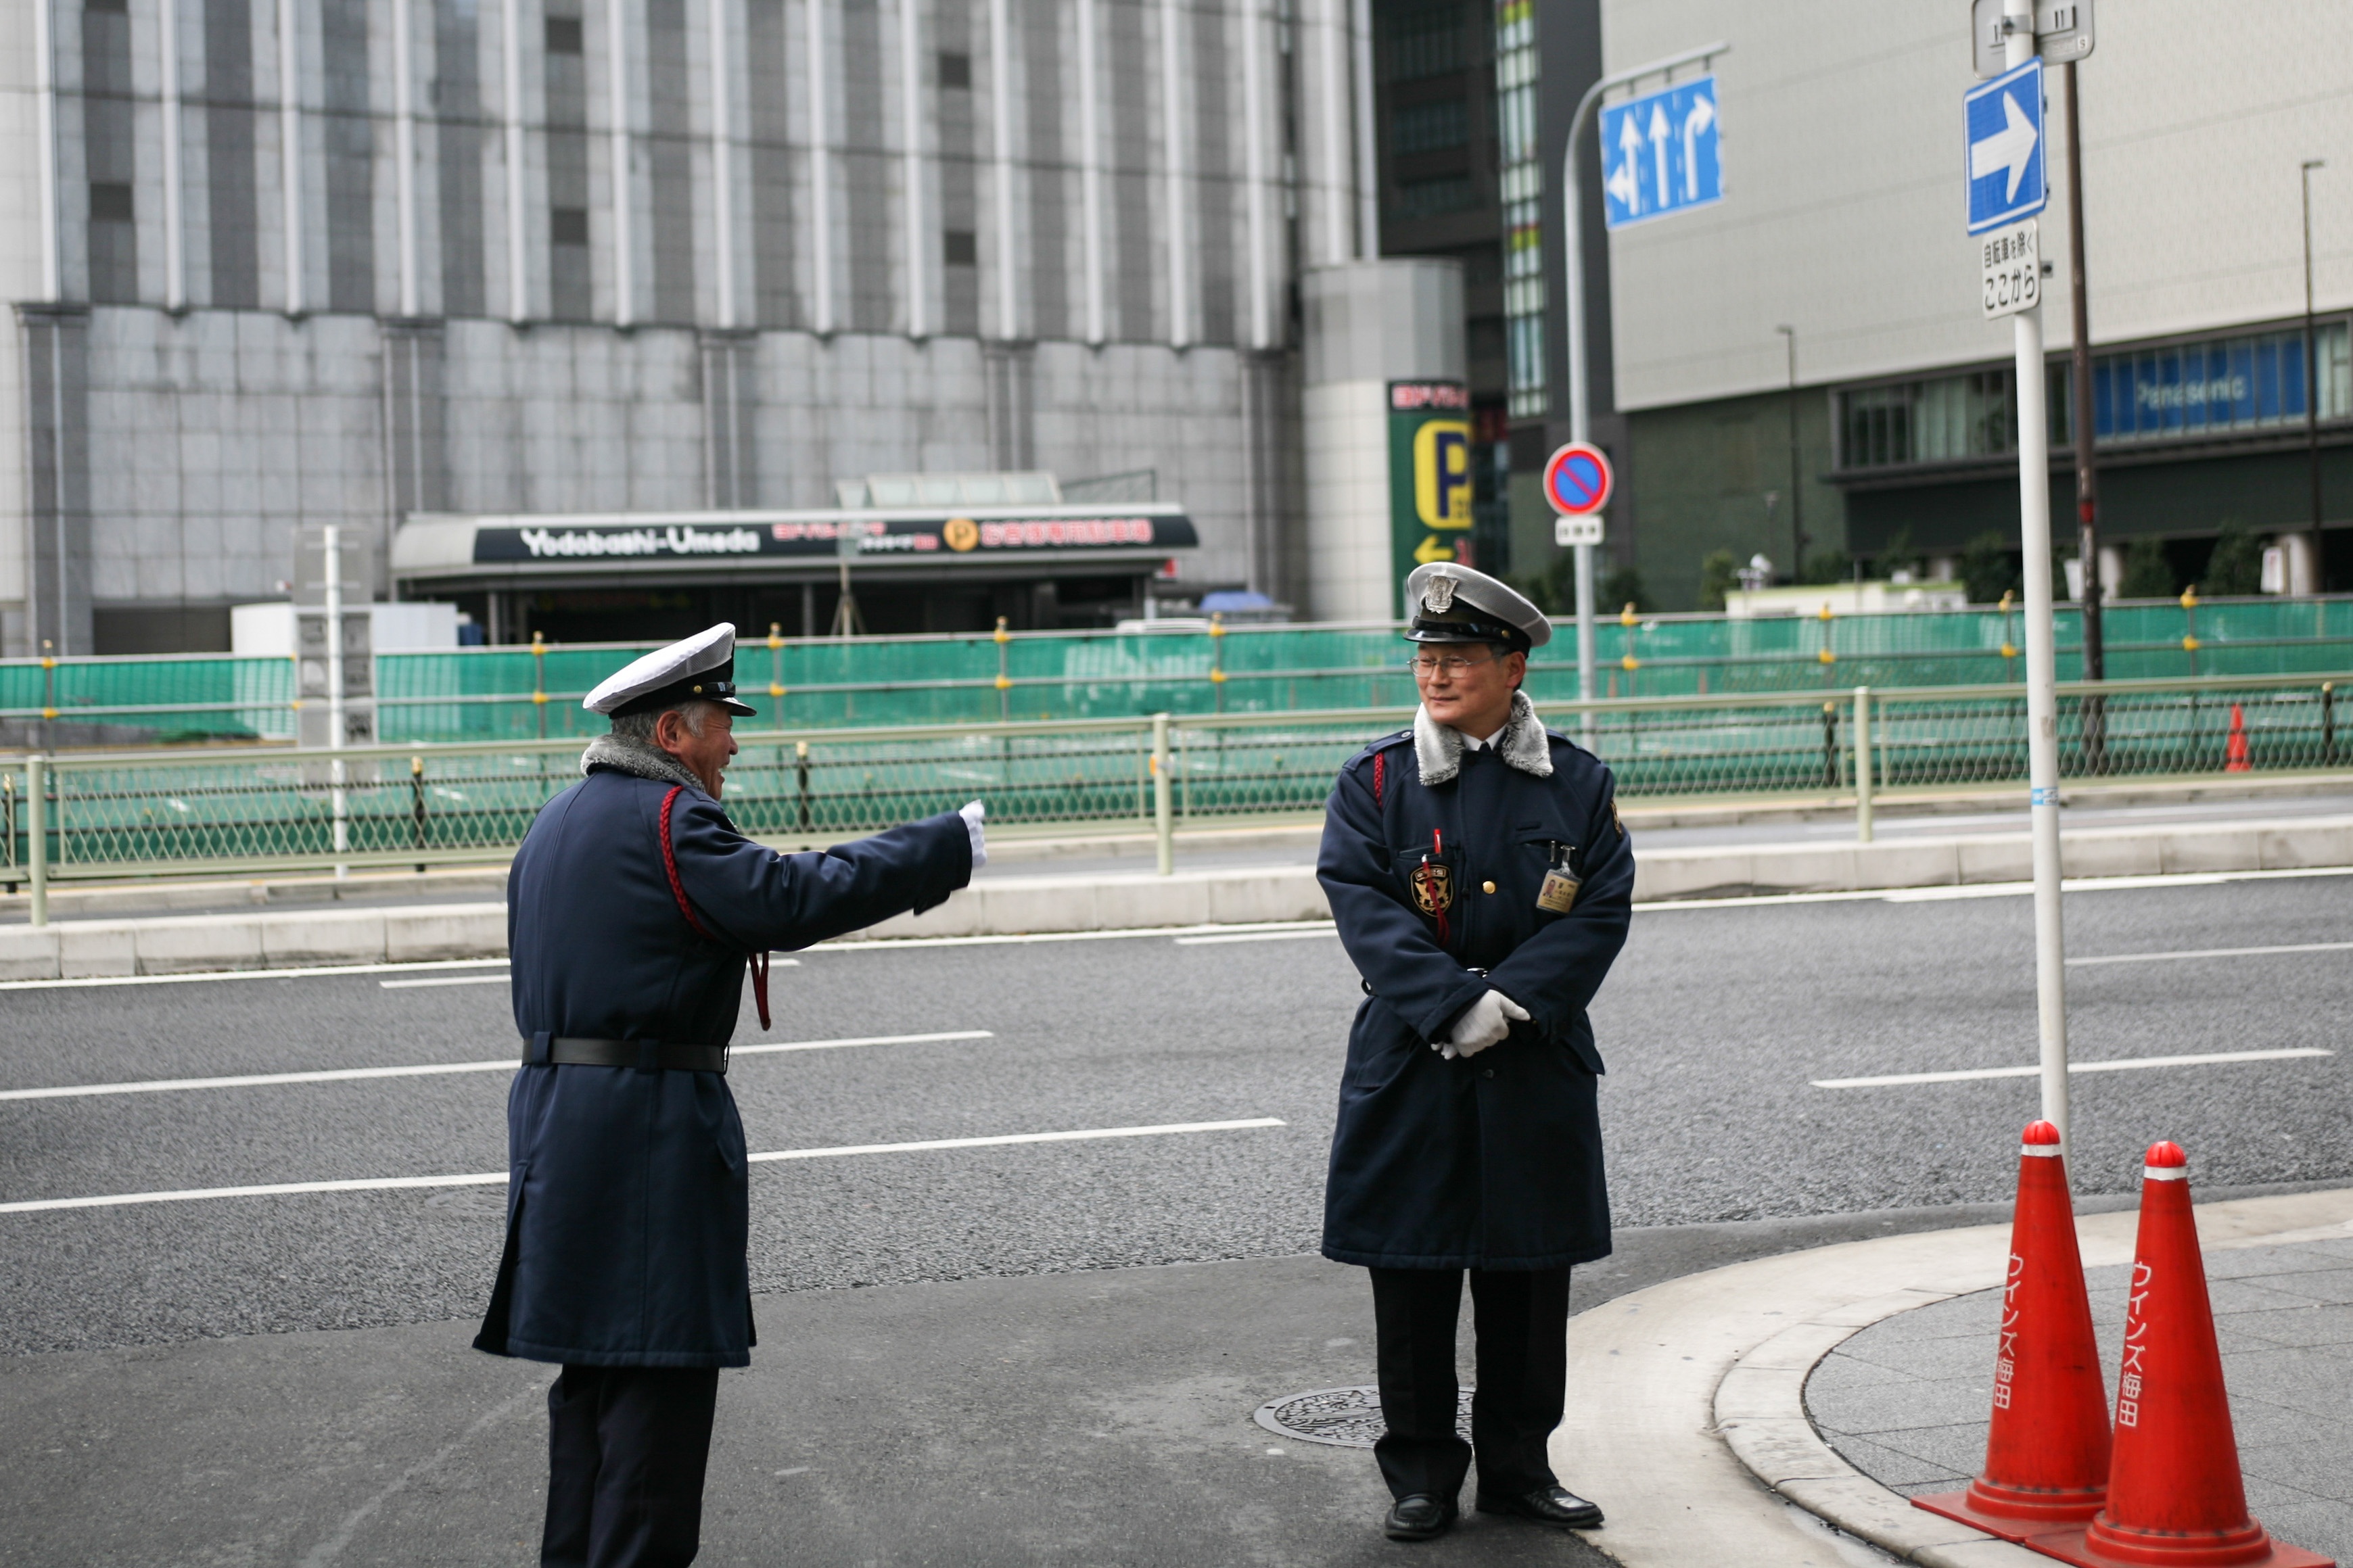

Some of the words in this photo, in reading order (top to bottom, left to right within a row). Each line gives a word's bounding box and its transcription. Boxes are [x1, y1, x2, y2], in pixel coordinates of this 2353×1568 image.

[1984, 231, 2032, 268] 自転車を除く
[1985, 264, 2034, 310] ここから
[1435, 432, 1469, 520] P
[1994, 1252, 2024, 1410] ウインズ梅田
[2118, 1260, 2152, 1428] ウインズ梅田
